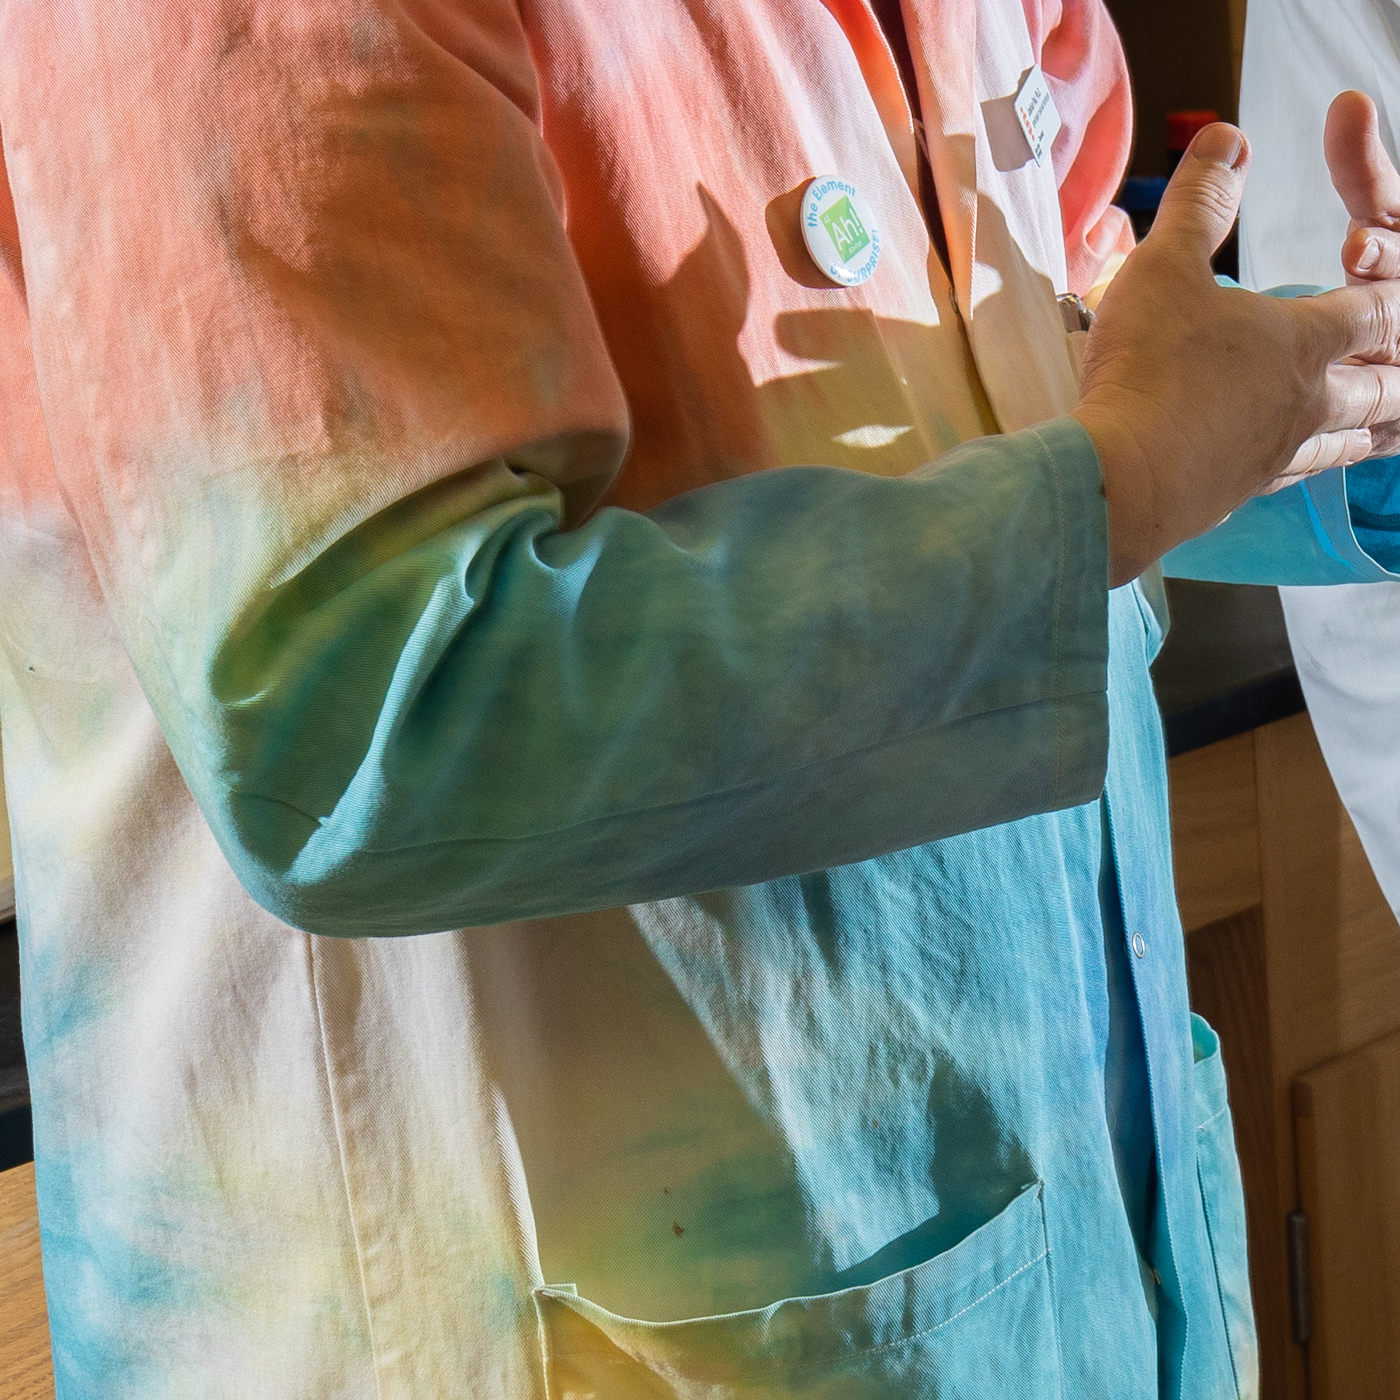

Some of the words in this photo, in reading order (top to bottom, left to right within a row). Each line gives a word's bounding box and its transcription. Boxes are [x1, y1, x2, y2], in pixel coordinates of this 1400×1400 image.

[812, 180, 856, 202] Element
[807, 202, 818, 228] the
[831, 208, 864, 251] Ah!
[847, 229, 880, 283] URPRISE!
